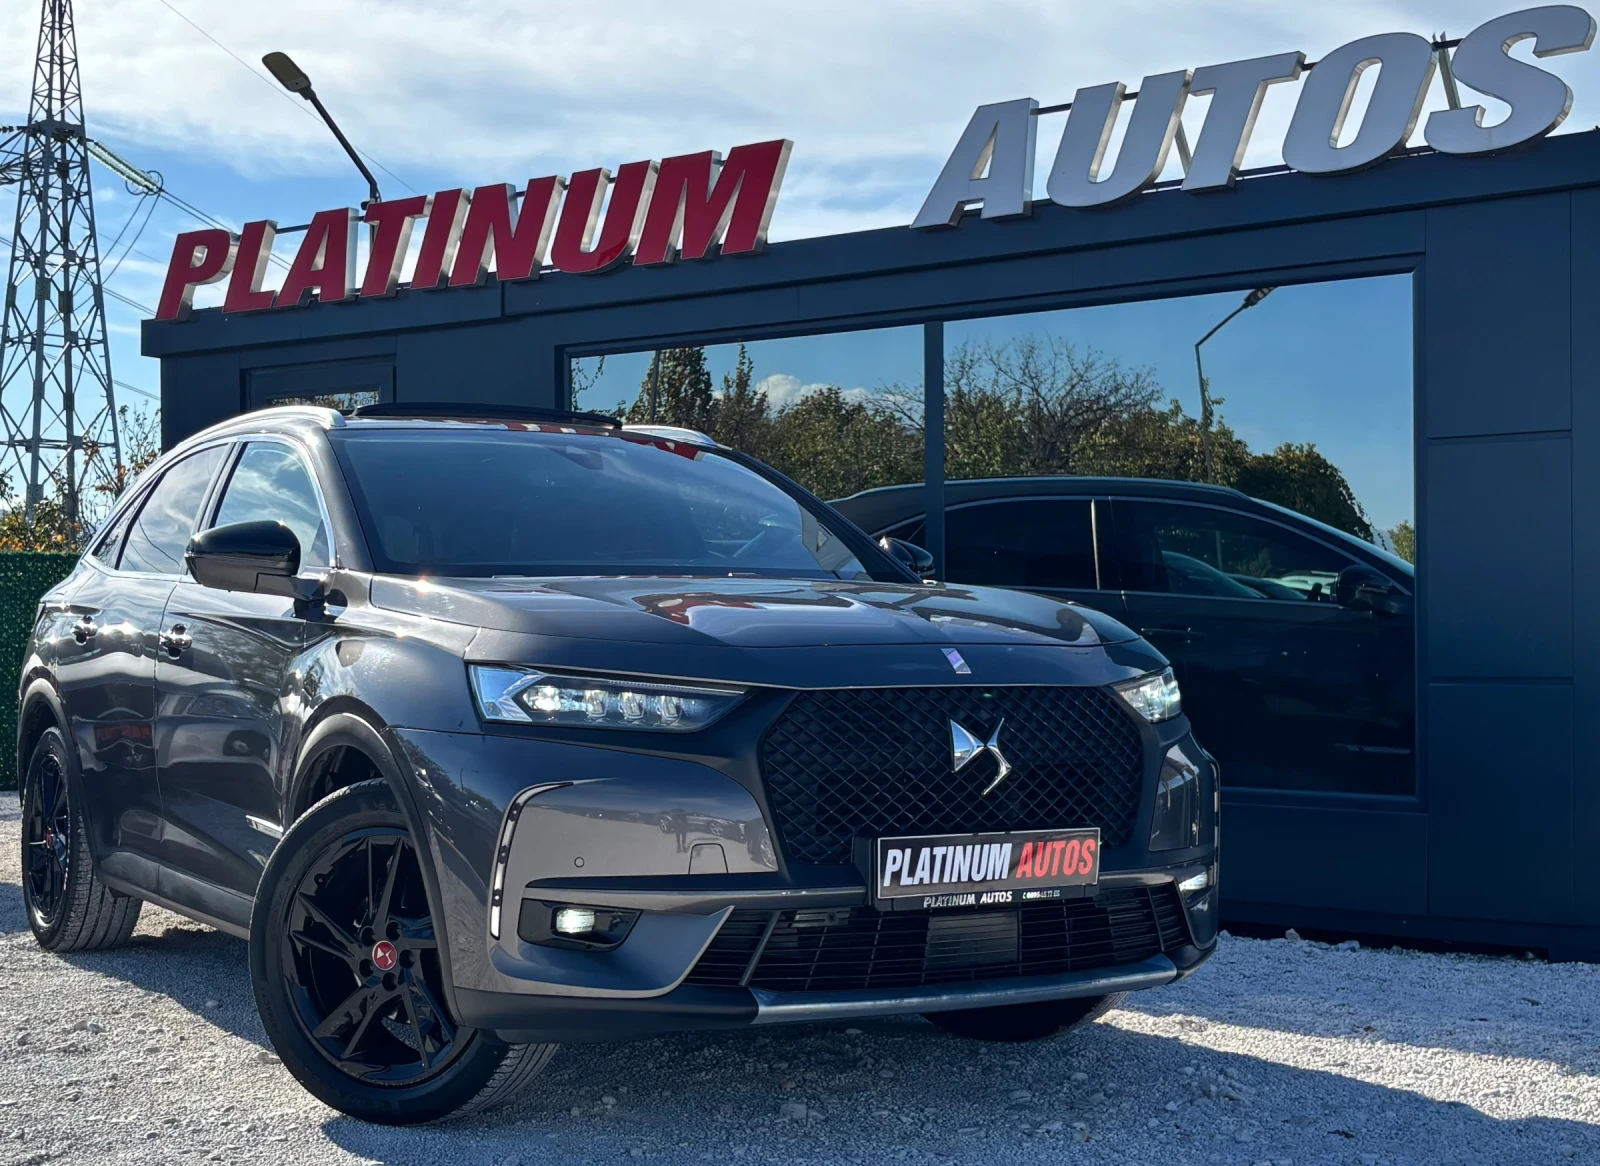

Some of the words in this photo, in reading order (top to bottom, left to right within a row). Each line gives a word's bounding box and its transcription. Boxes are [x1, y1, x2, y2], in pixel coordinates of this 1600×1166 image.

[156, 139, 793, 320] PLATINUM
[910, 4, 1597, 229] AUTOS
[883, 842, 1012, 887] PLATINUM
[1016, 838, 1096, 879] AUTOS
[923, 893, 976, 908] PLATINUM
[980, 891, 1013, 904] AUTOS
